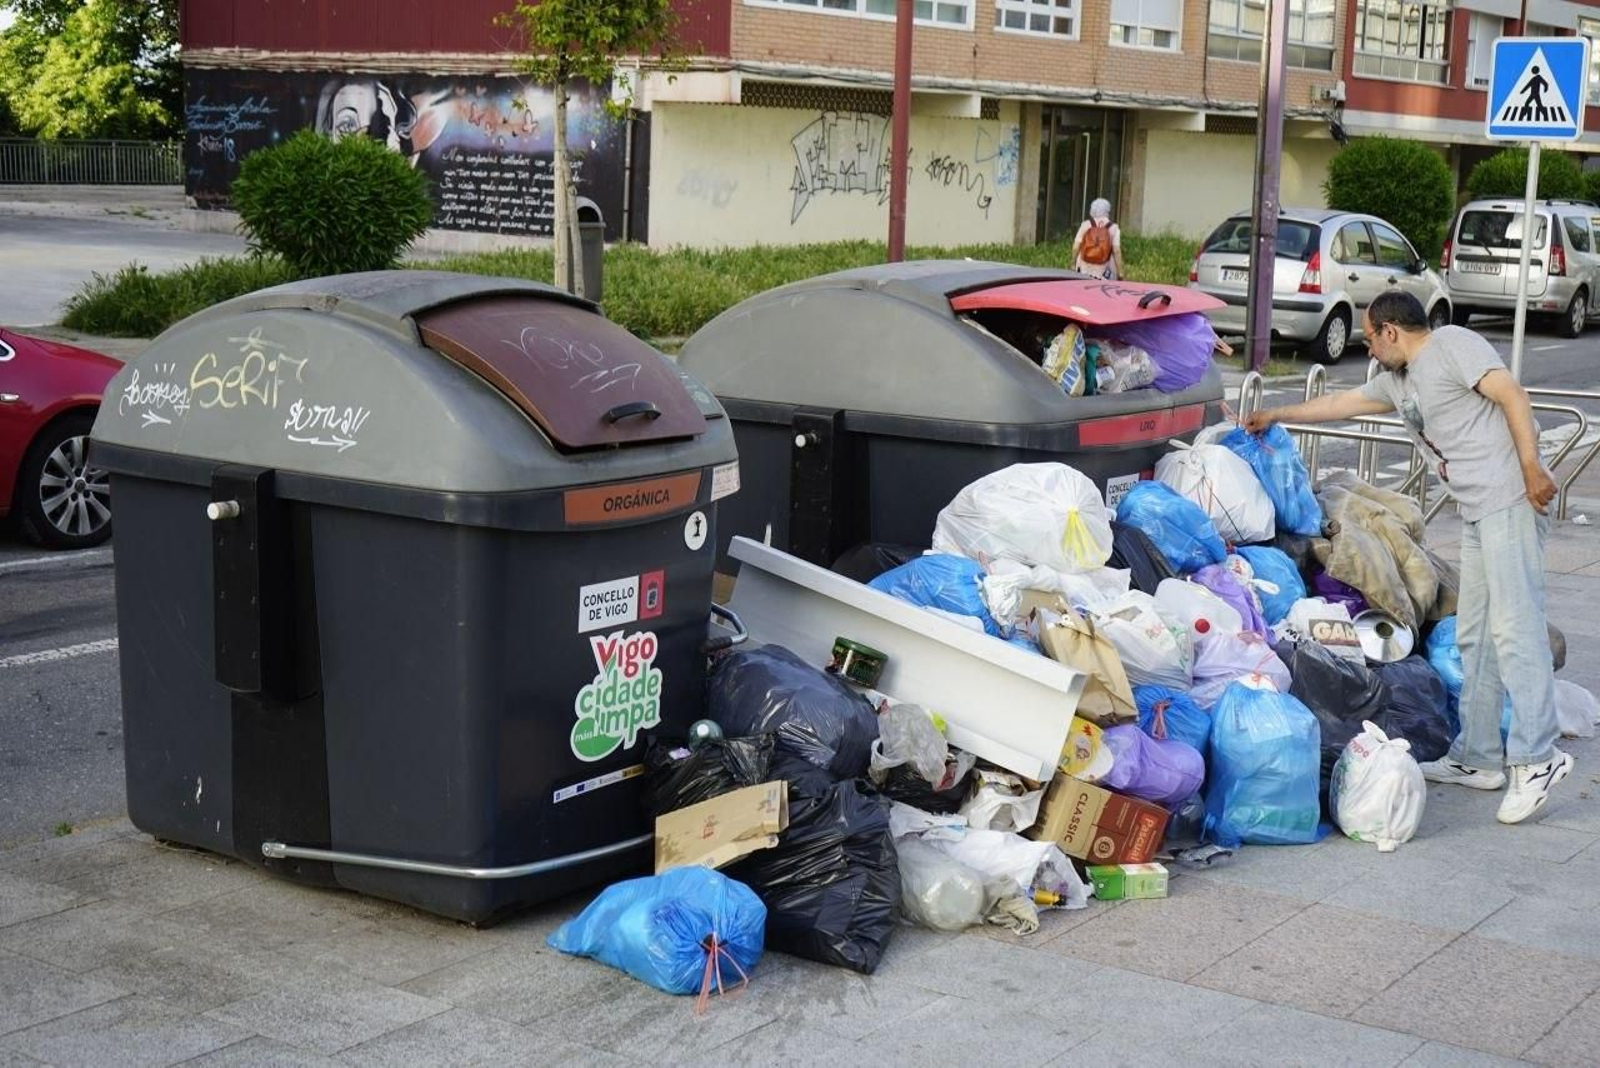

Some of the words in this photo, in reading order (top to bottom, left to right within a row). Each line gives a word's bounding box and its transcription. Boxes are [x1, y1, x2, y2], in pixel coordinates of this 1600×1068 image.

[603, 488, 670, 513] ORGÁNICA
[583, 587, 635, 607] CONCELLO
[589, 609, 602, 620] DE
[605, 603, 628, 617] VIGO
[597, 637, 655, 678] Vigo
[580, 662, 659, 713] cidade
[594, 700, 657, 742] limpa
[1064, 792, 1088, 844] CLASSIC
